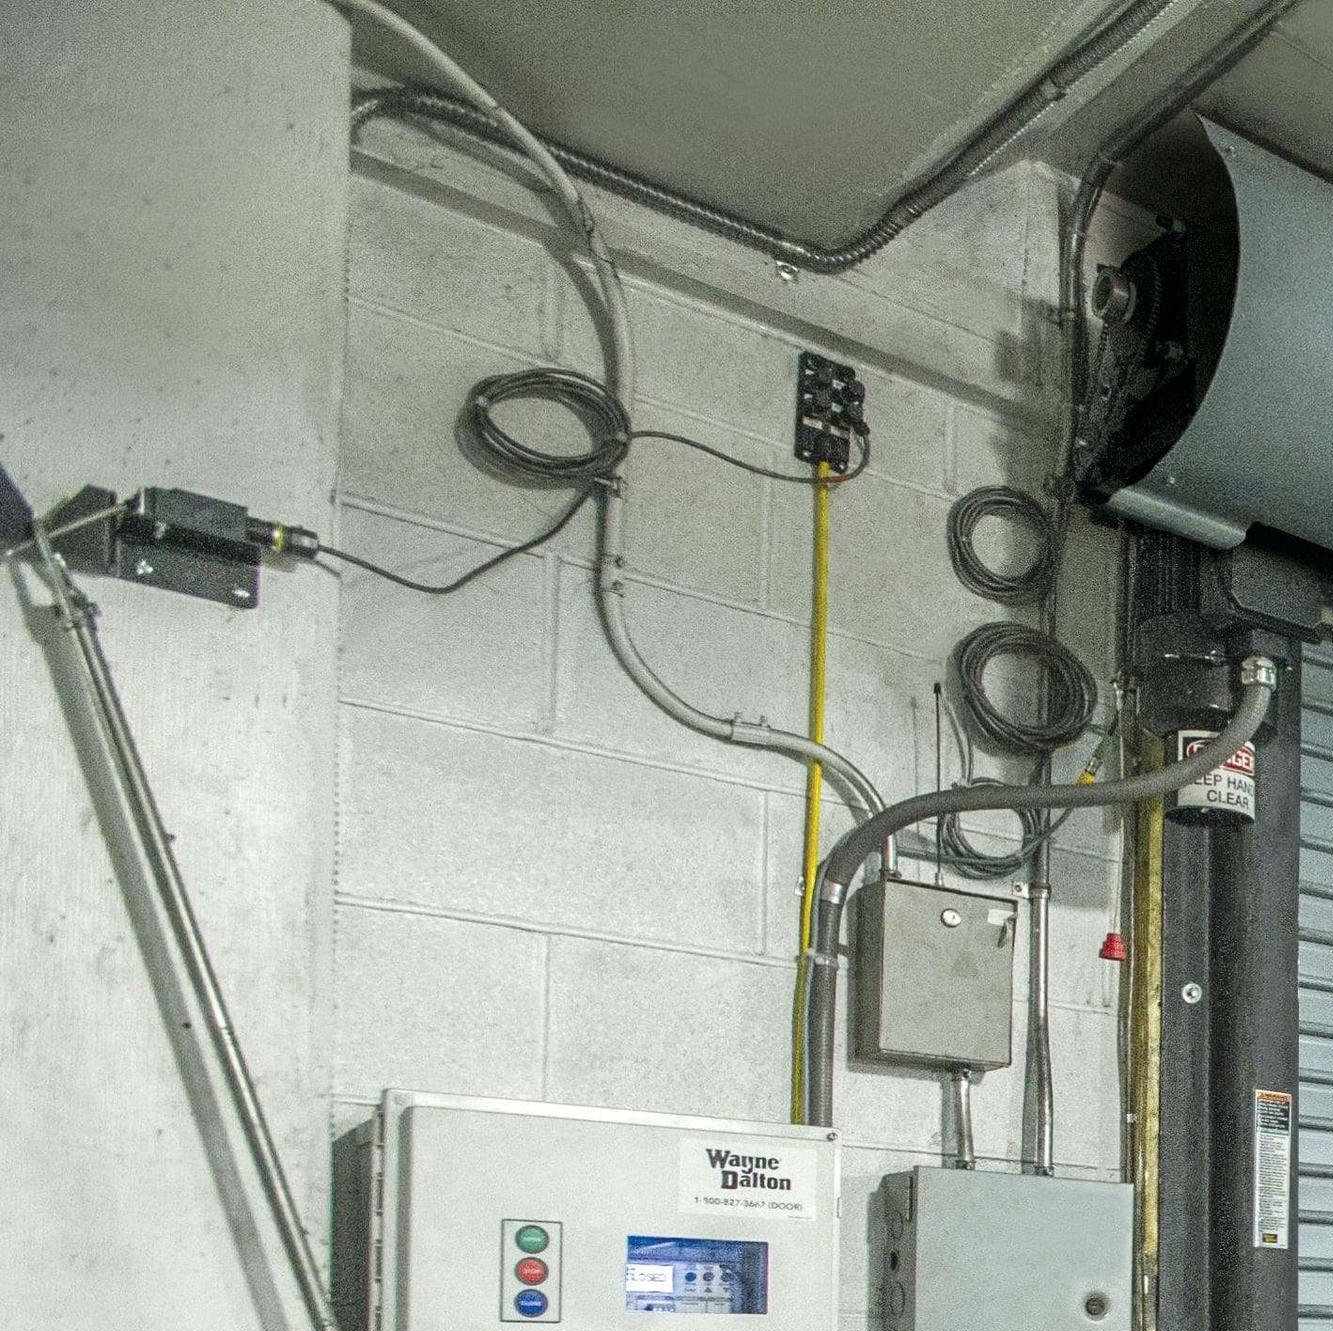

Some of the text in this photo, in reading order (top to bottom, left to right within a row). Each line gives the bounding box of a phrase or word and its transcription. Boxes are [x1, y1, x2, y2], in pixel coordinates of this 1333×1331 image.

[1207, 790, 1249, 810] CLEAR
[705, 1148, 780, 1174] Wayne
[721, 1170, 792, 1190] Dalton
[768, 1201, 802, 1211] (DOOR)
